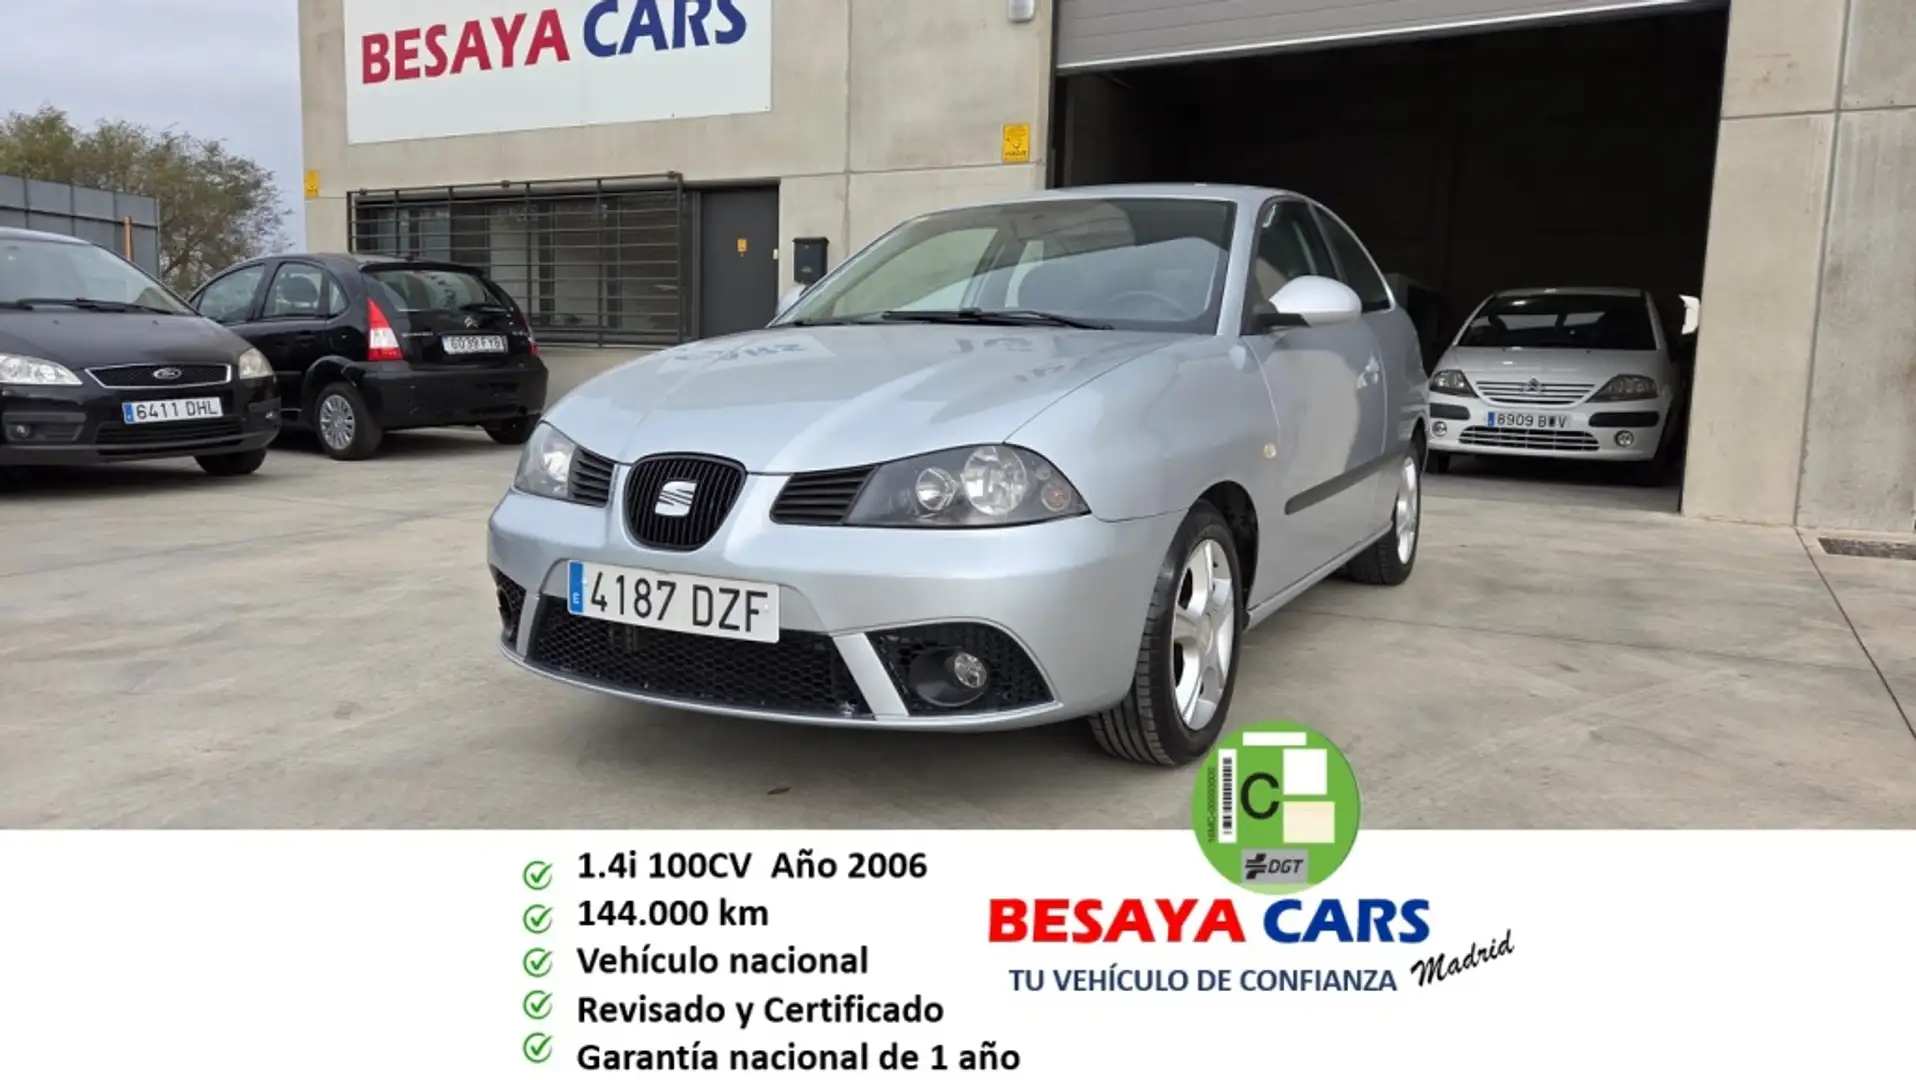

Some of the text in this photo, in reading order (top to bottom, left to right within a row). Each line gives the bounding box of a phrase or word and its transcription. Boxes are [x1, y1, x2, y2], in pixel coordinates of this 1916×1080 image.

[361, 0, 747, 84] BESAYA CARS
[136, 400, 218, 420] 6411 DHL
[1497, 413, 1534, 426] 8909
[590, 571, 769, 632] 4187 DZF
